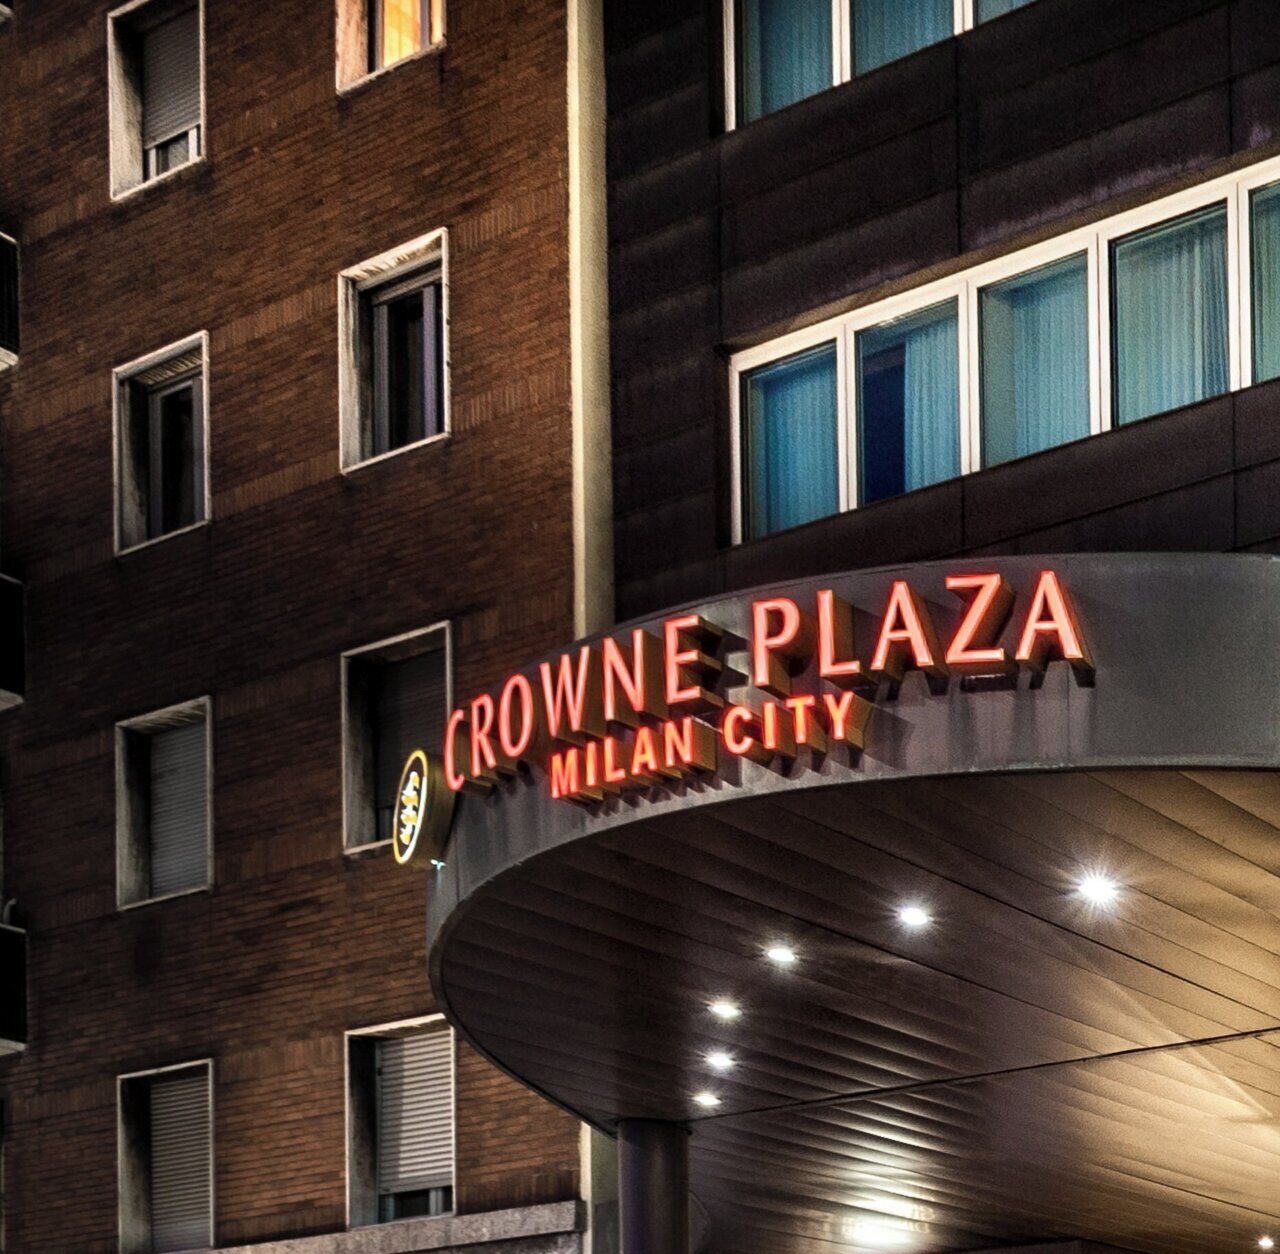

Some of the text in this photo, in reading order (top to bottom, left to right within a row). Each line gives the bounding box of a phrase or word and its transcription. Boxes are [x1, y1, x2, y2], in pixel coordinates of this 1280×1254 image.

[442, 569, 1085, 791] CROWNE PLAZA
[549, 690, 857, 800] MILAN CITY
